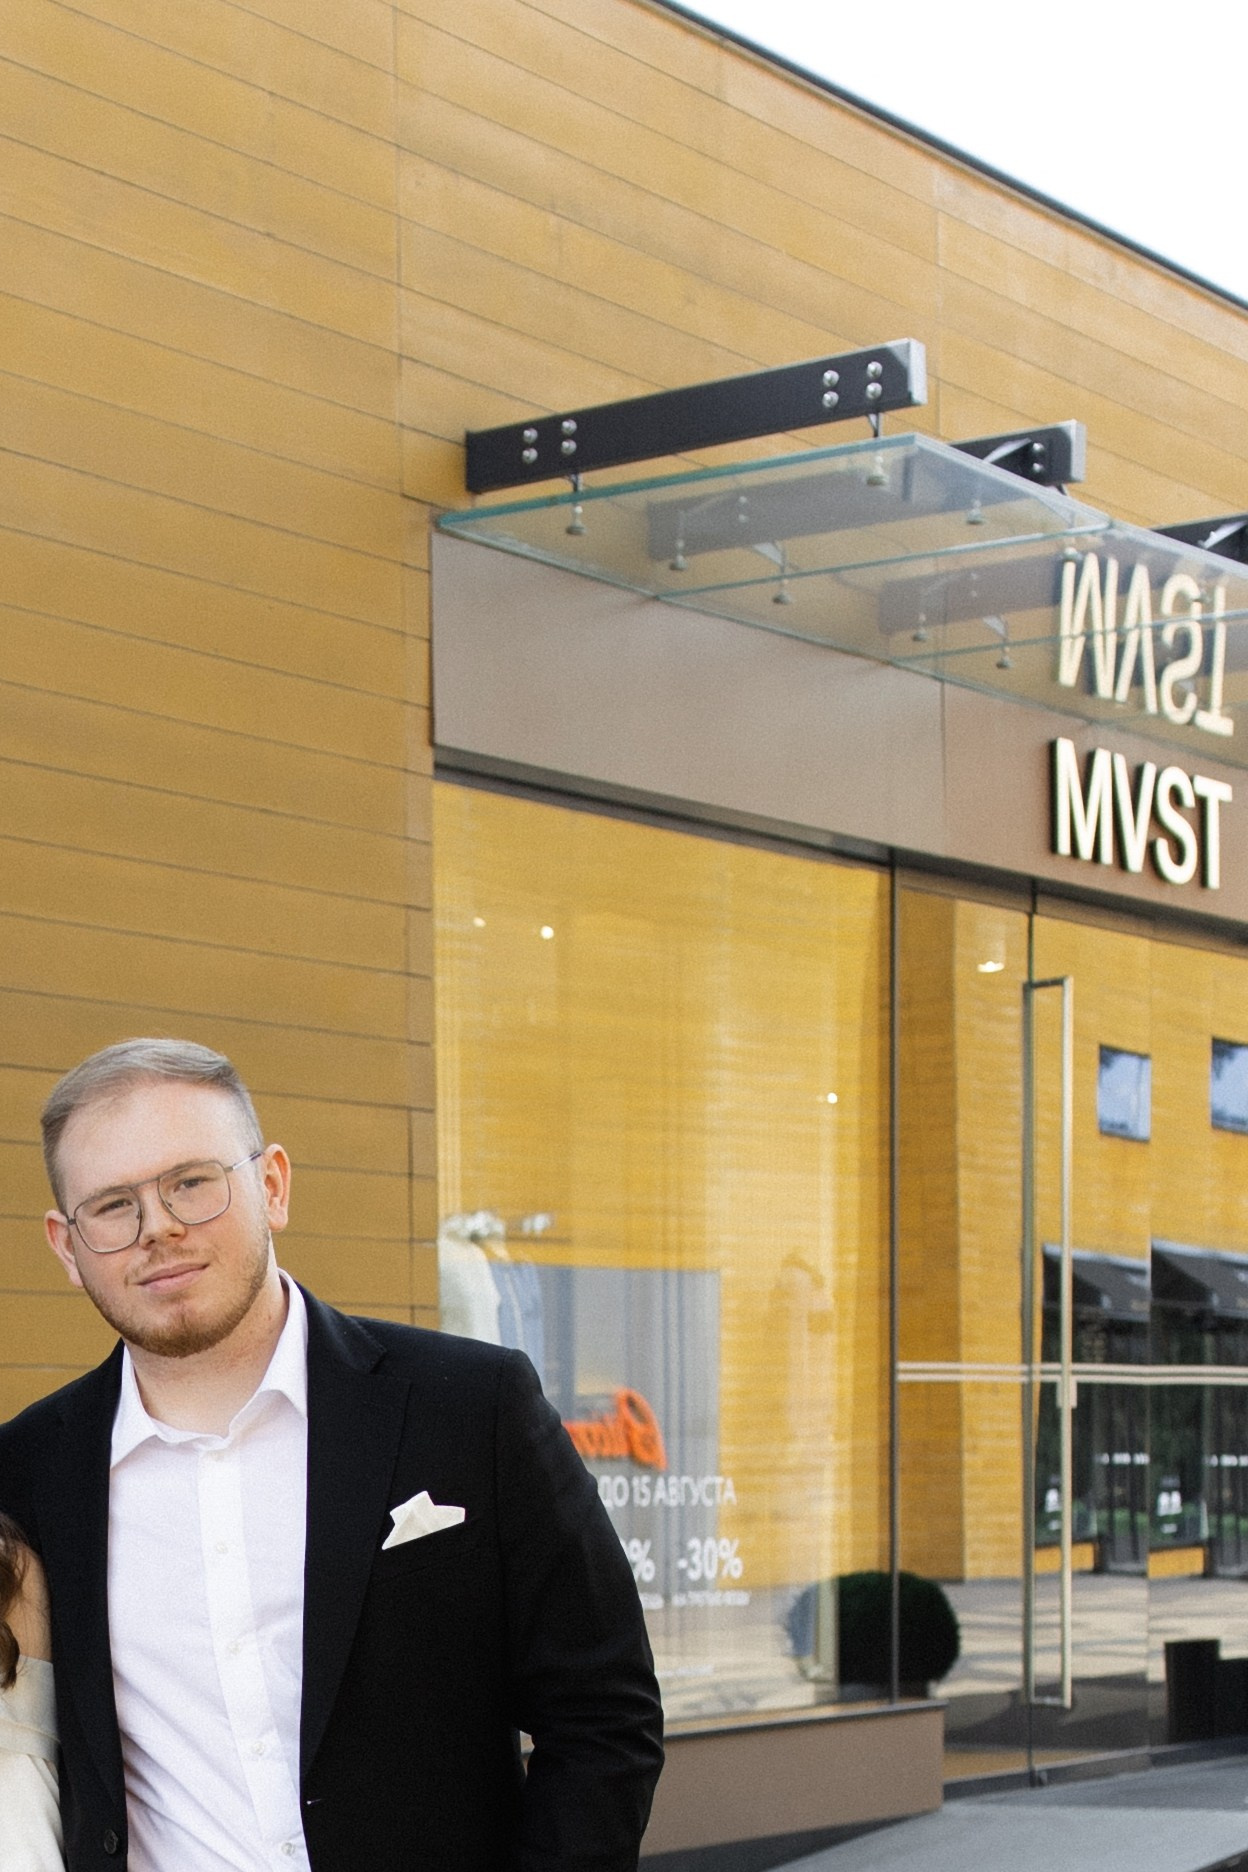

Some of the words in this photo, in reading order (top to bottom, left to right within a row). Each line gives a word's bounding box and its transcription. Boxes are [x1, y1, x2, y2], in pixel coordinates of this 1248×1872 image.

[1053, 736, 1233, 890] MVST
[632, 1475, 652, 1507] 15
[653, 1475, 738, 1507] АВГУСТА
[677, 1536, 743, 1581] -30%
